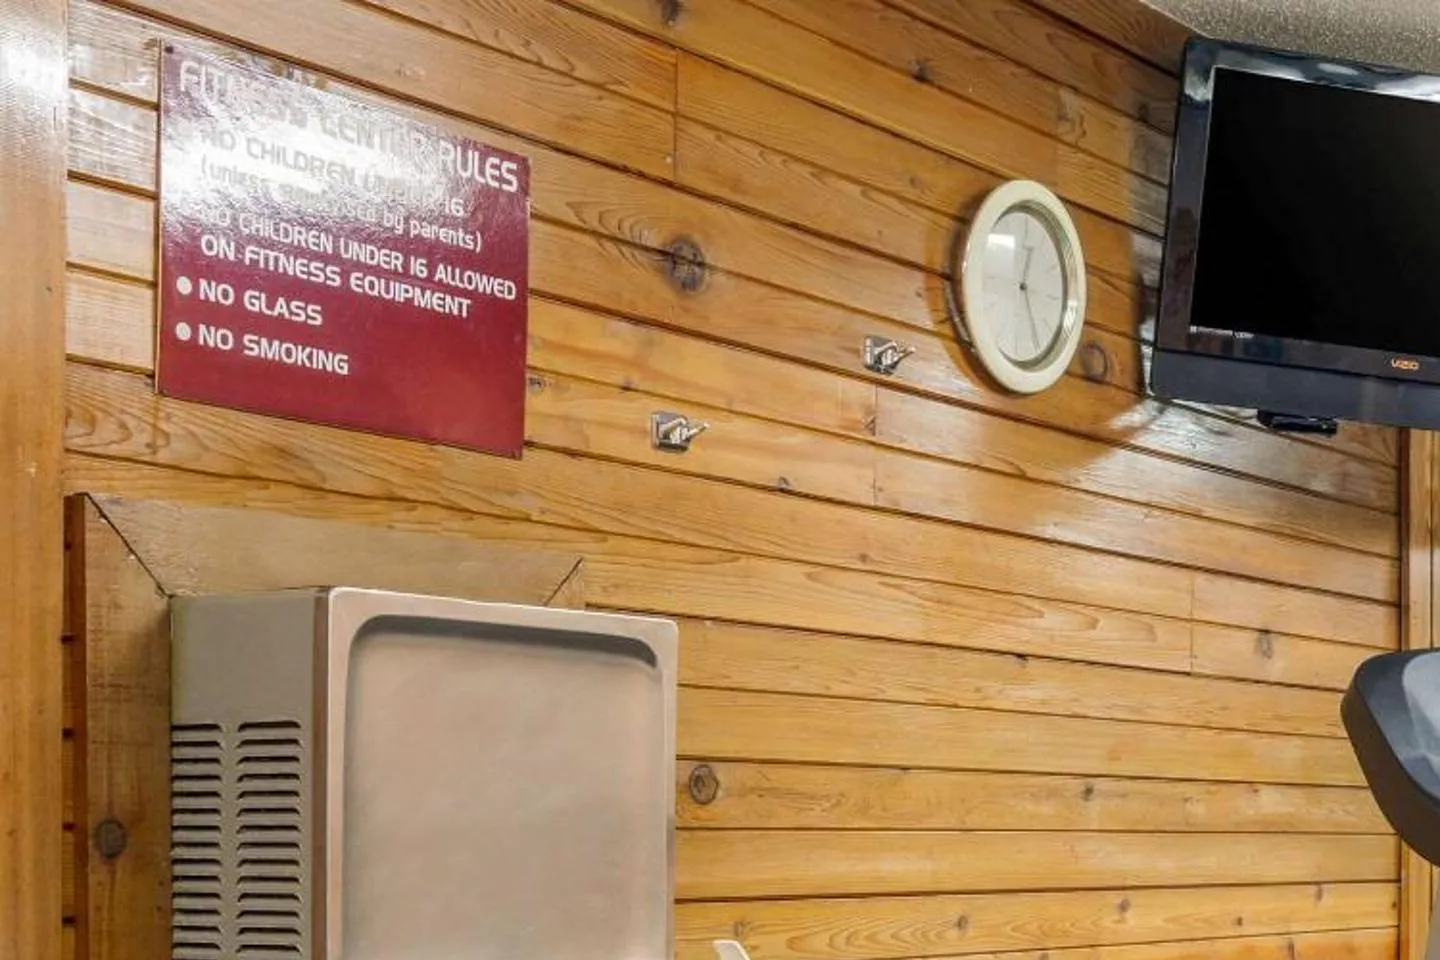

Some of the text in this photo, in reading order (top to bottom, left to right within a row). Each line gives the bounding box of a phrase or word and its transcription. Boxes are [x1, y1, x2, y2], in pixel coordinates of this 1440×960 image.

[246, 136, 356, 186] CHILDREN
[444, 196, 465, 217] 16
[438, 139, 518, 193] RULES
[240, 213, 333, 254] CHILDREN
[340, 238, 403, 273] UNDER
[410, 256, 428, 278] 16
[434, 263, 517, 300] ALLOWED
[384, 206, 404, 235] by
[410, 220, 482, 253] parents)
[199, 278, 323, 326] NO GLASS
[201, 234, 472, 319] ON FITNESS EQUIPMENT
[198, 323, 349, 376] NO SMOKING
